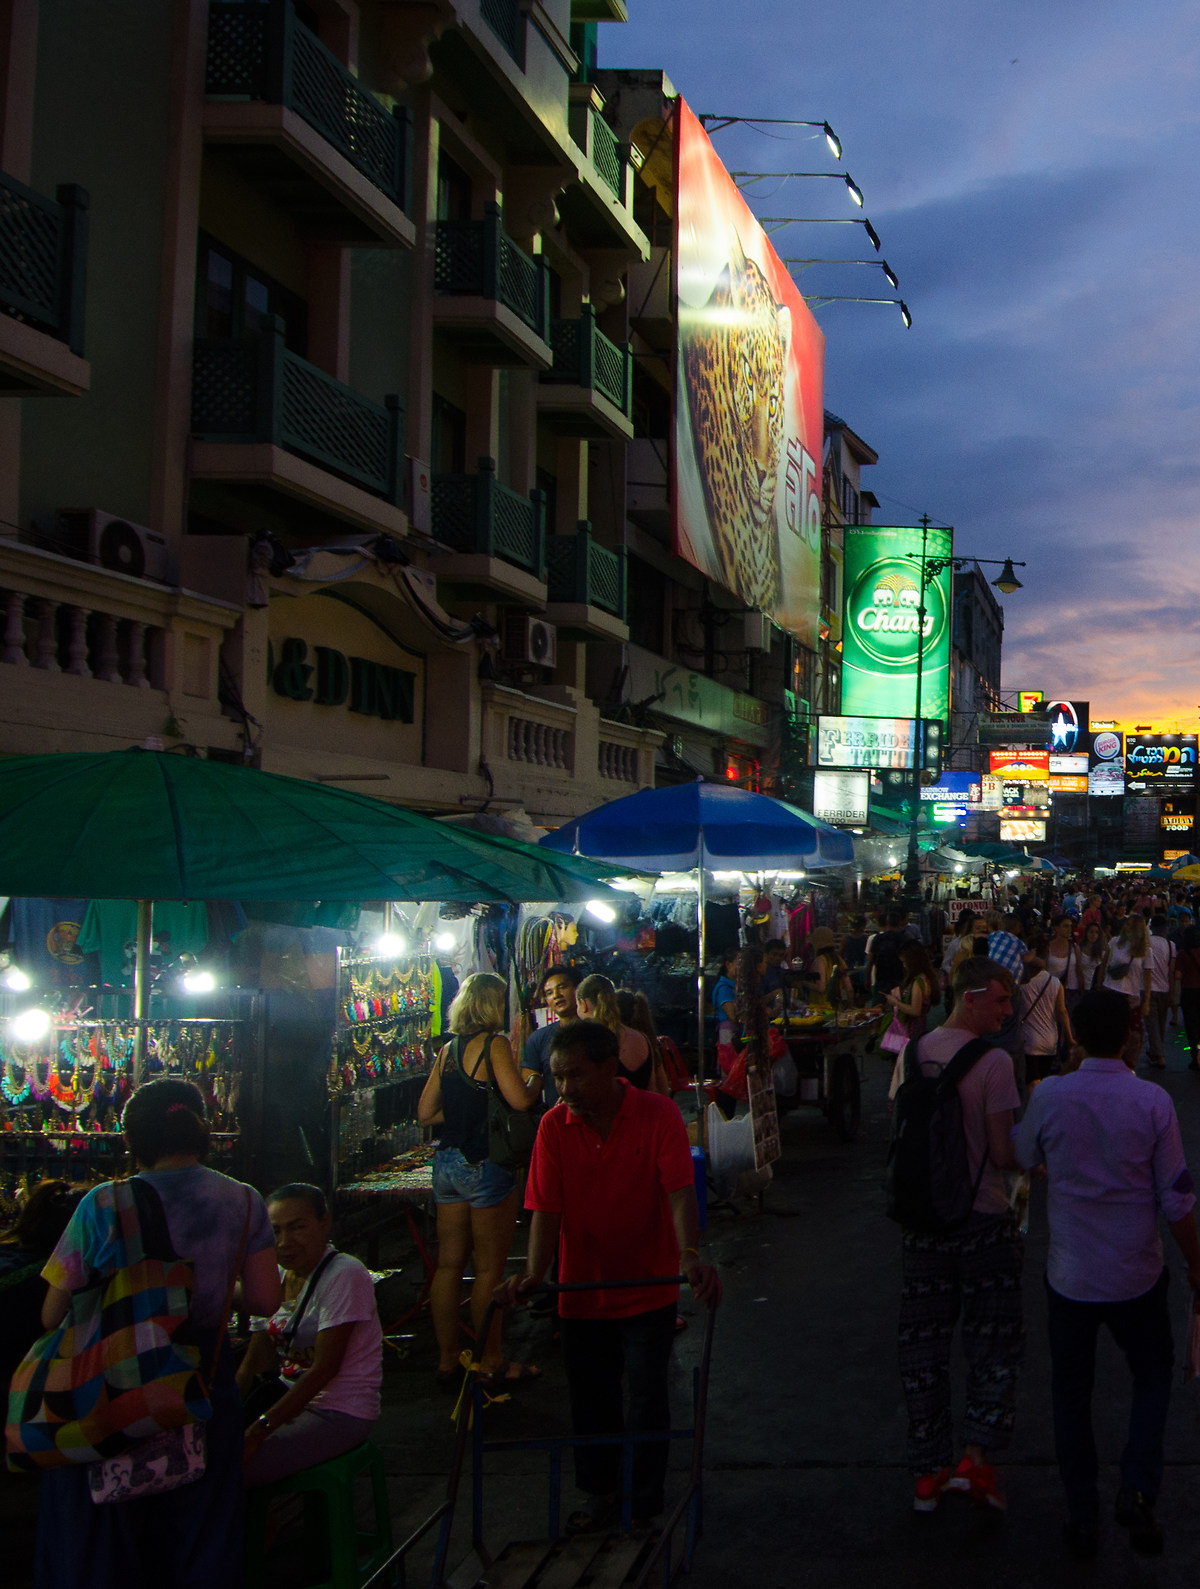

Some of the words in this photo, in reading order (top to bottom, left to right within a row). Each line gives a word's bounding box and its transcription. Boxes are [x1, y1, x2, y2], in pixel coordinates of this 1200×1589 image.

[857, 607, 935, 638] Chang
[1098, 741, 1117, 752] KING
[920, 792, 969, 801] EXCHANGE
[817, 809, 865, 818] FERRIDER
[951, 901, 988, 911] COCONUT
